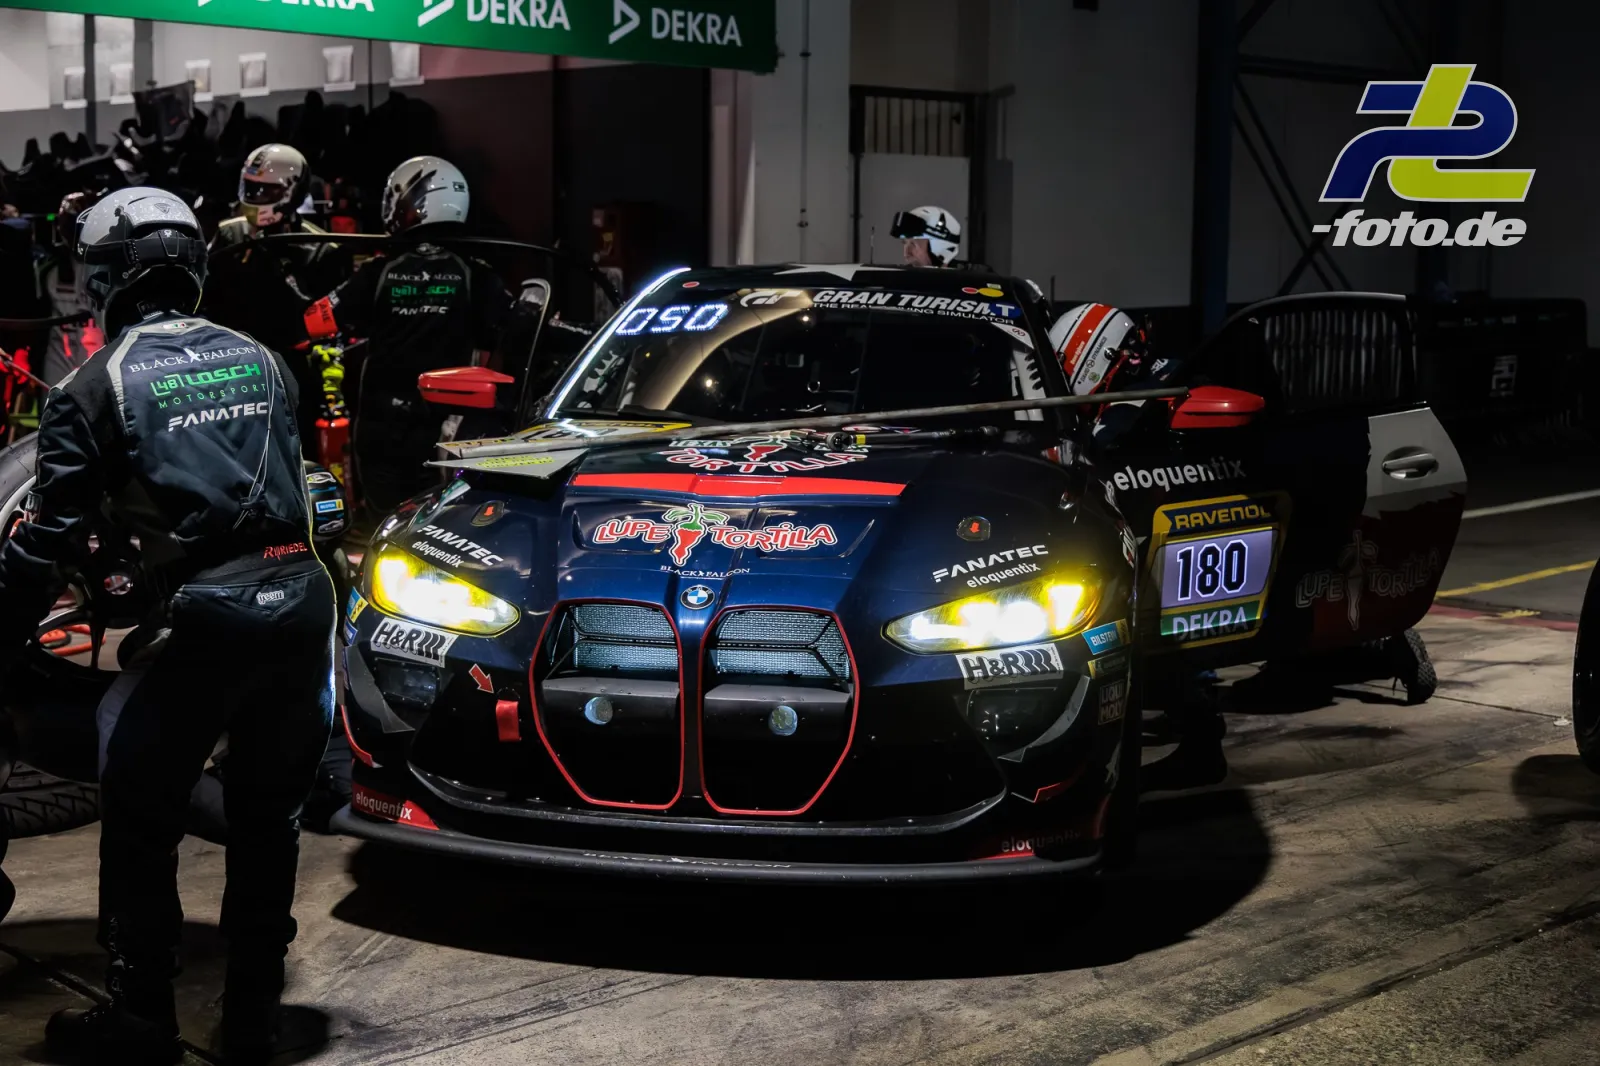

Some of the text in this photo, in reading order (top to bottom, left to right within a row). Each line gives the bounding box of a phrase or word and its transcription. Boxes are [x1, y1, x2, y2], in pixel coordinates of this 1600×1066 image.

[466, 0, 571, 31] DEKRA
[651, 8, 743, 47] DEKRA
[812, 290, 894, 305] GRAN
[937, 308, 1014, 325] SIMULATOR
[127, 345, 258, 374] BLACK FALCON
[184, 363, 262, 386] LOSCH
[157, 382, 267, 410] MOTORSPORT
[167, 401, 269, 433] FANATEC
[1113, 455, 1247, 493] eloquentix
[1173, 503, 1272, 531] RAVENOL
[416, 524, 505, 567] FANATEC
[592, 517, 838, 553] LUPE TORTILLA
[411, 540, 465, 570] eloquentix
[932, 544, 1049, 583] FANATEC
[1176, 538, 1249, 601] 180
[659, 564, 750, 578] BLACK FALCON
[966, 561, 1042, 589] eloquentix
[1171, 606, 1251, 643] DEKRA
[355, 790, 413, 821] eloquentix
